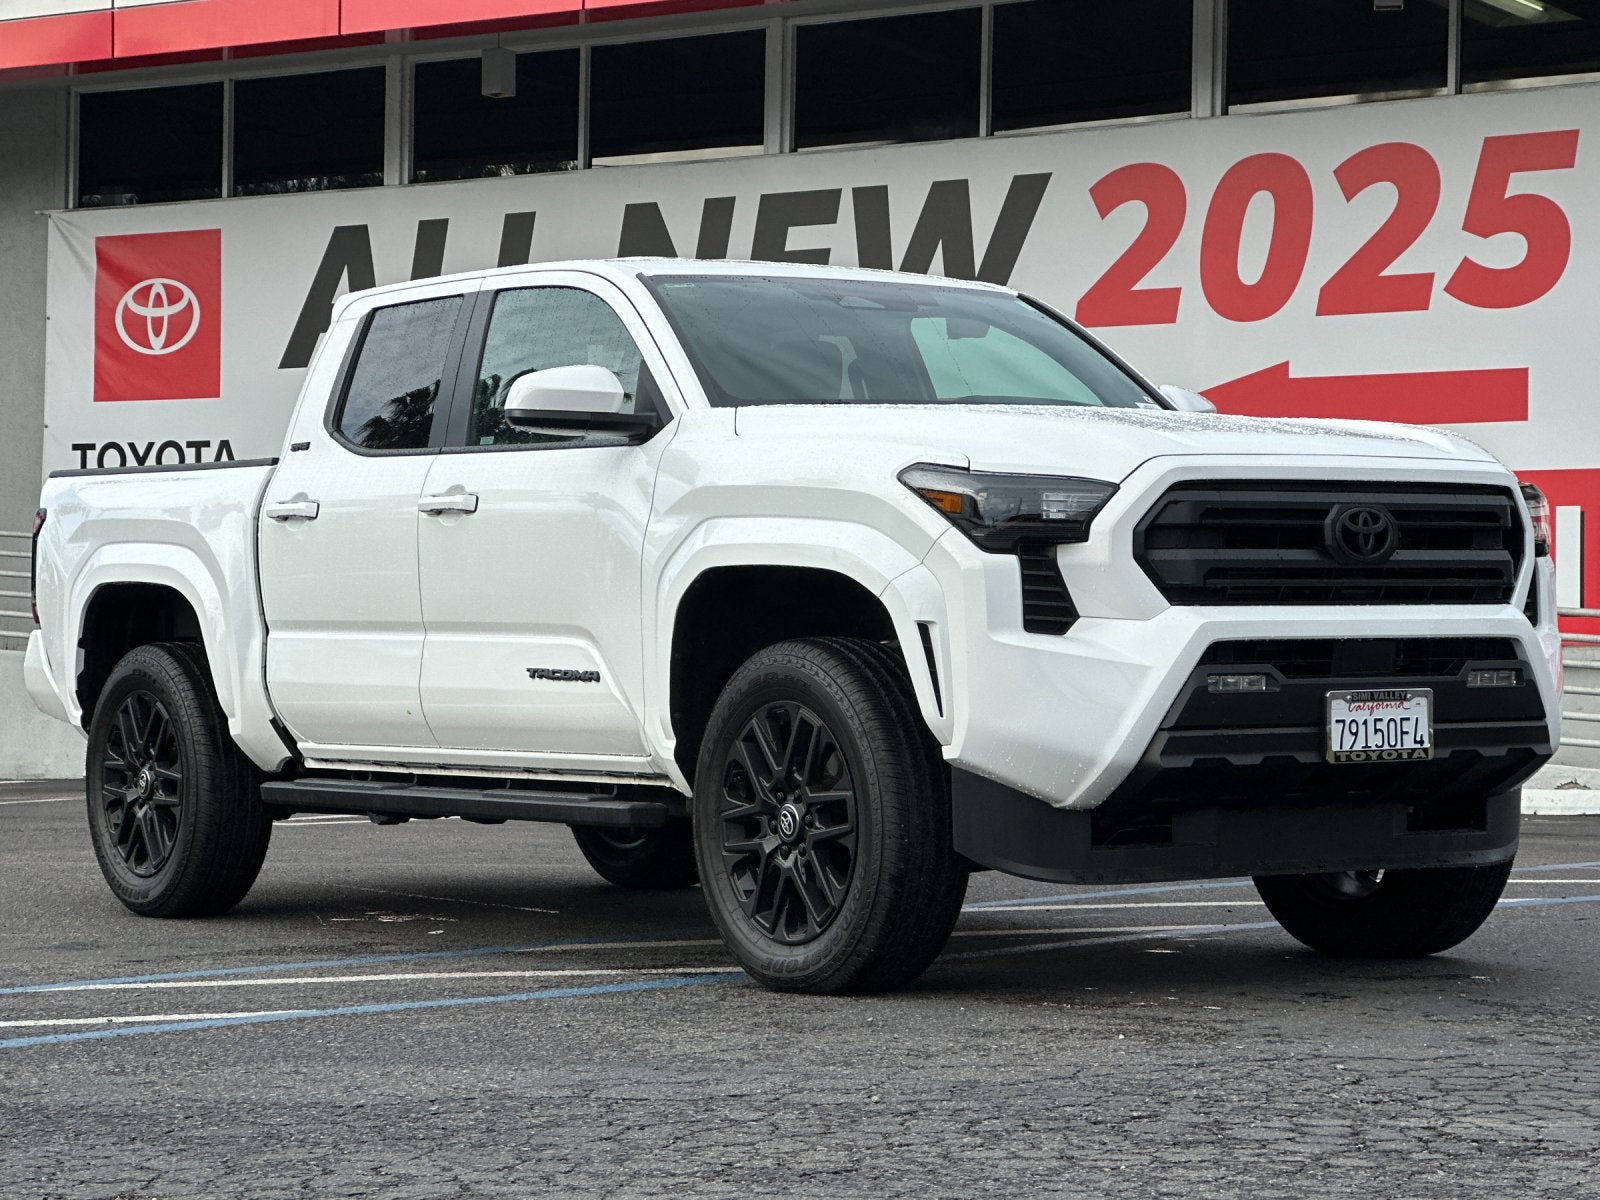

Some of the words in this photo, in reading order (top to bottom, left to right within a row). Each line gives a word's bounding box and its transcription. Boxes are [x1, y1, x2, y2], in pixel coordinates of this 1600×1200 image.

[1075, 129, 1580, 328] 2025
[526, 668, 600, 683] TACOMA
[1353, 692, 1371, 701] SIMI
[1374, 691, 1406, 700] VALLEY
[1335, 717, 1425, 750] 79150F4
[1337, 749, 1425, 761] TOYOTA
